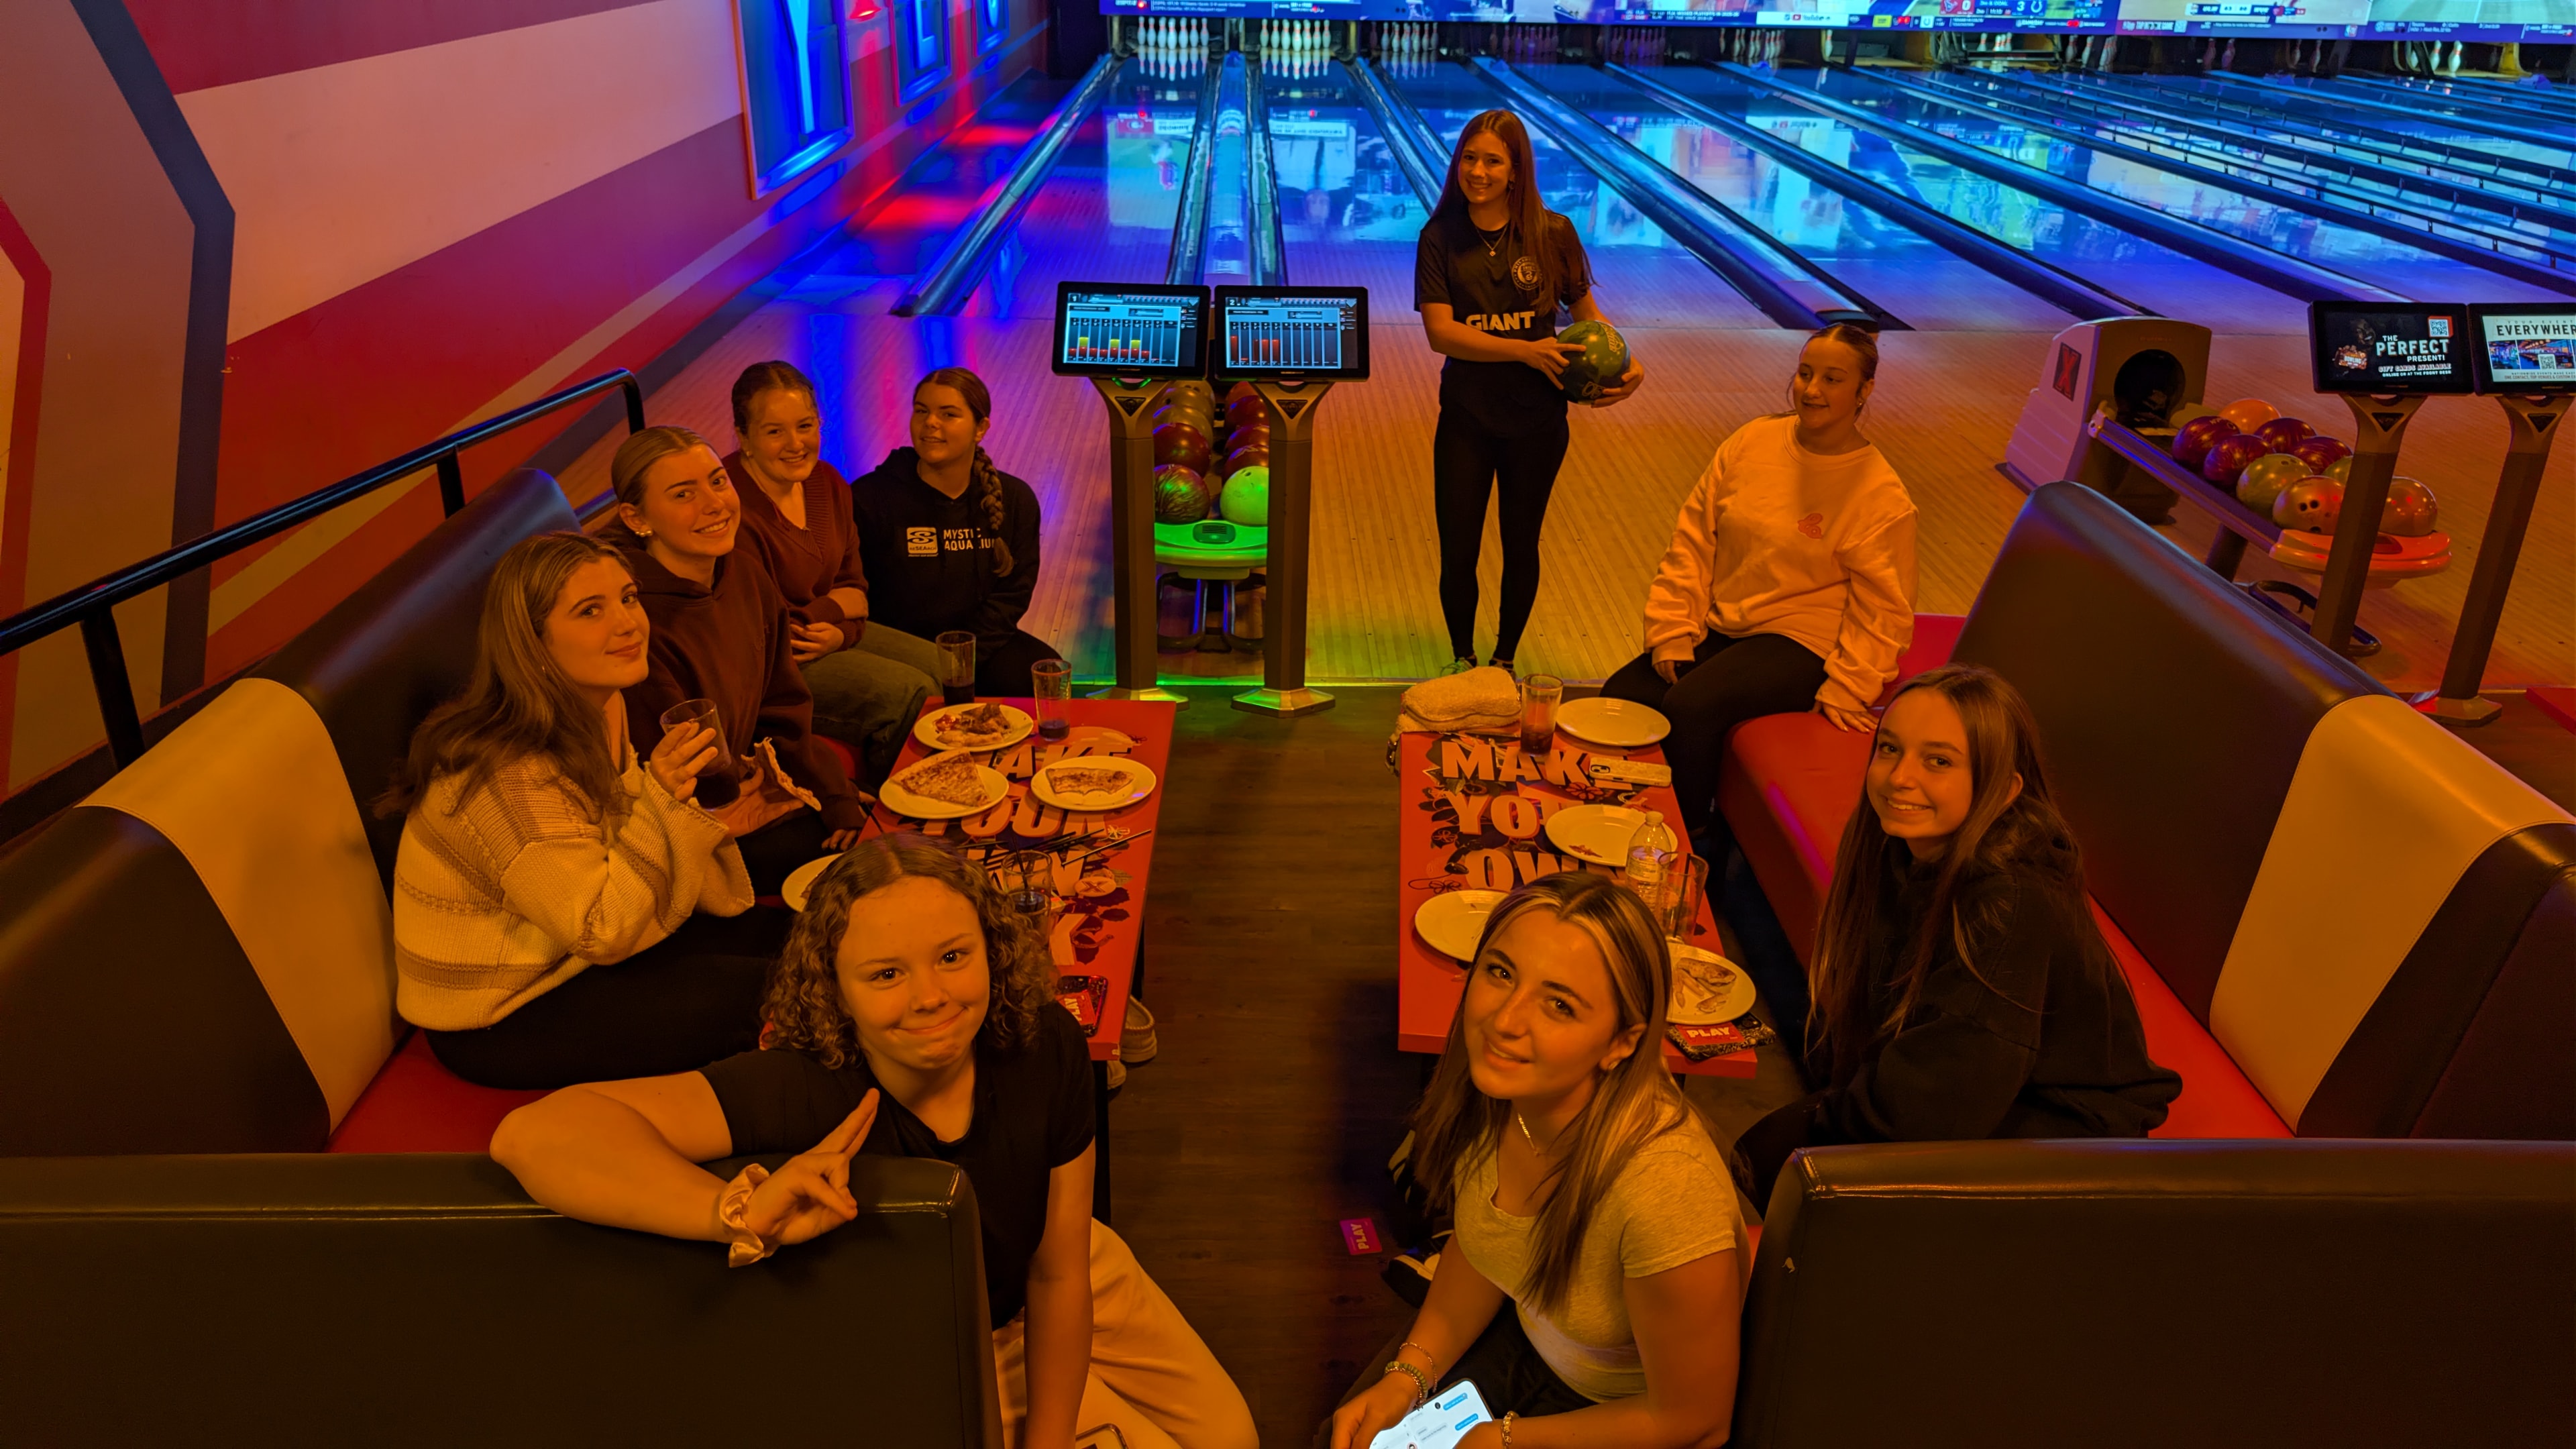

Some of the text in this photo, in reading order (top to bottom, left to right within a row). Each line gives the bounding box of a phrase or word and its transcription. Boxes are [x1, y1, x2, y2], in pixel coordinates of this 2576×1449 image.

[1962, 0, 1971, 11] 0
[2017, 1, 2025, 11] 3
[1466, 311, 1535, 330] GIANT
[2376, 339, 2449, 356] PERFECT
[2407, 354, 2445, 362] PRESENT!
[2417, 363, 2452, 371] AVAILABLE
[1686, 1027, 1729, 1038] PLAY
[1350, 1224, 1369, 1249] PLAY
